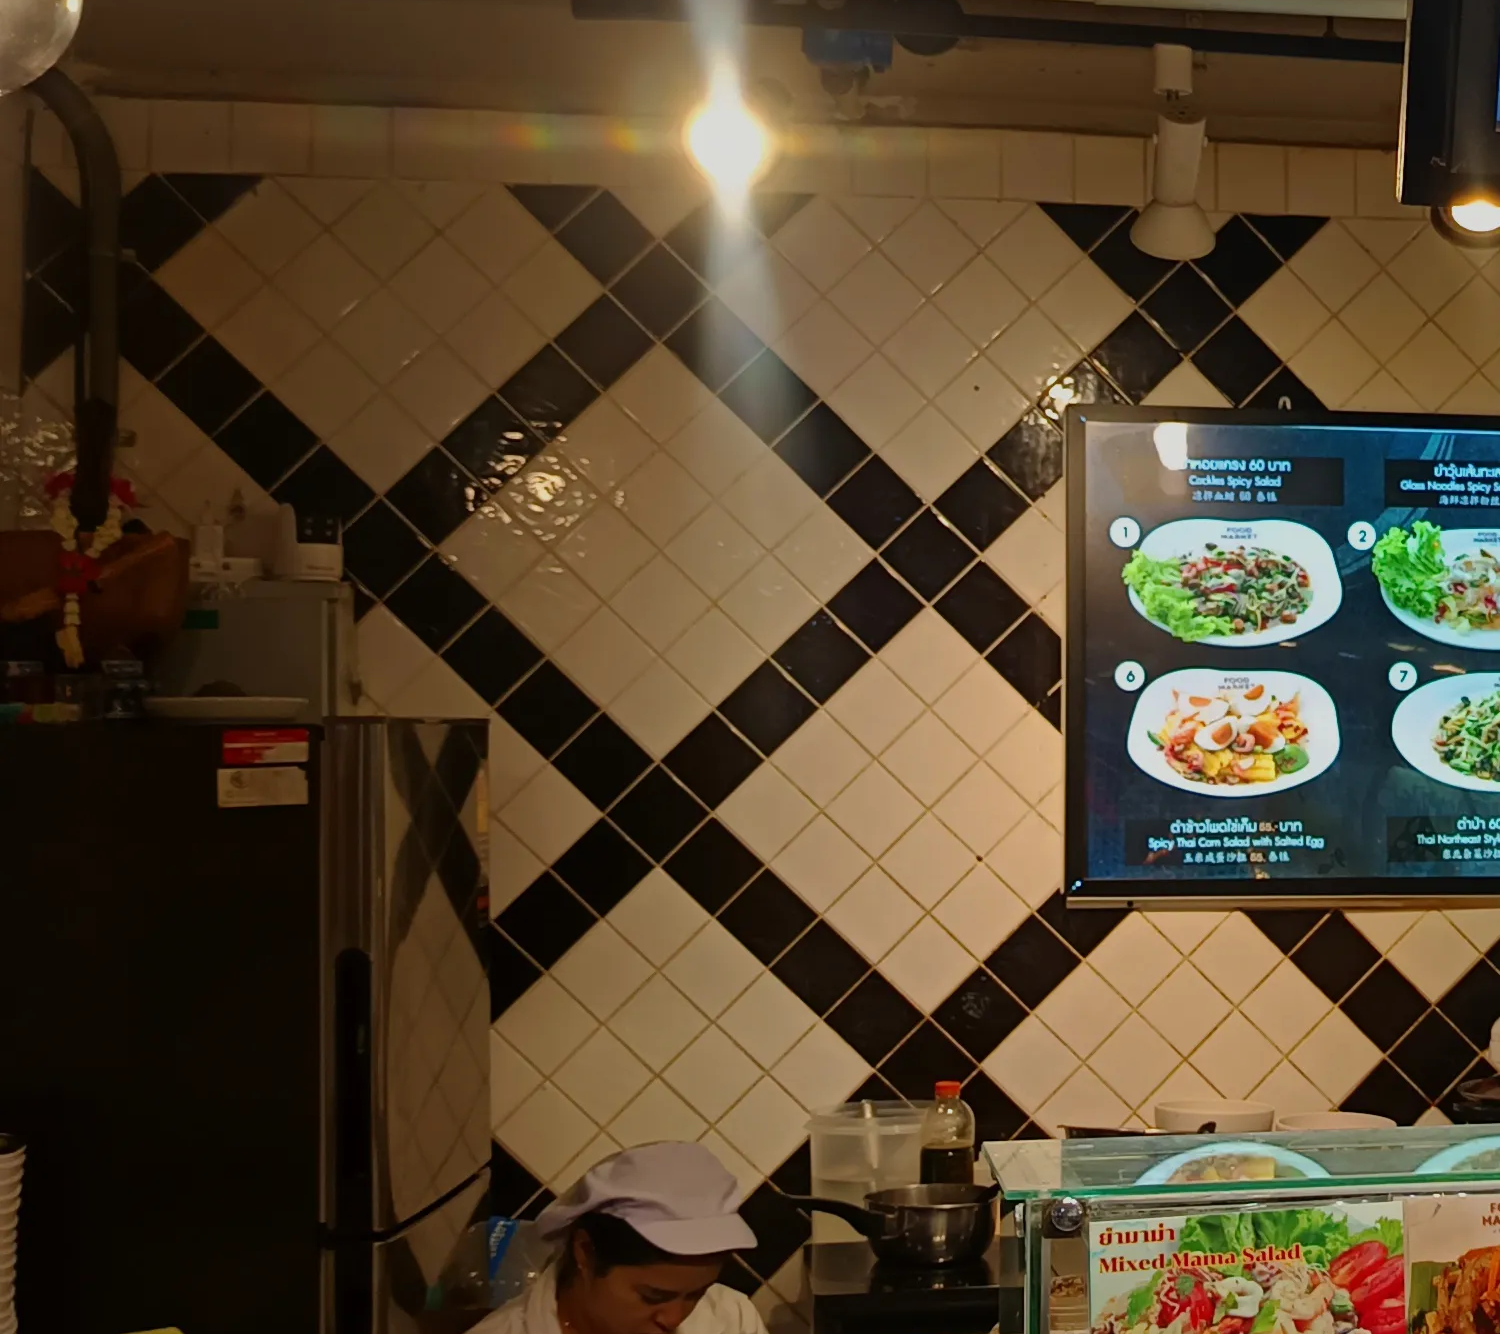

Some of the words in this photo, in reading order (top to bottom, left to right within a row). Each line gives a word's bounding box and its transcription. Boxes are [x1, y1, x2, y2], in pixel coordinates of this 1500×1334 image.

[1123, 526, 1129, 538] 1
[1358, 530, 1367, 543] 2
[1126, 670, 1135, 683] 6
[1400, 670, 1408, 683] 7
[1148, 837, 1175, 851] Spicy
[1176, 836, 1196, 848] Thai
[1222, 836, 1250, 848] Salad
[1252, 836, 1273, 847] with
[1416, 834, 1436, 845] Thai
[1099, 1223, 1175, 1246] ยำมาม่า
[1099, 1253, 1165, 1274] Mixed
[1171, 1250, 1236, 1269] Mama
[1241, 1243, 1301, 1264] Salad
